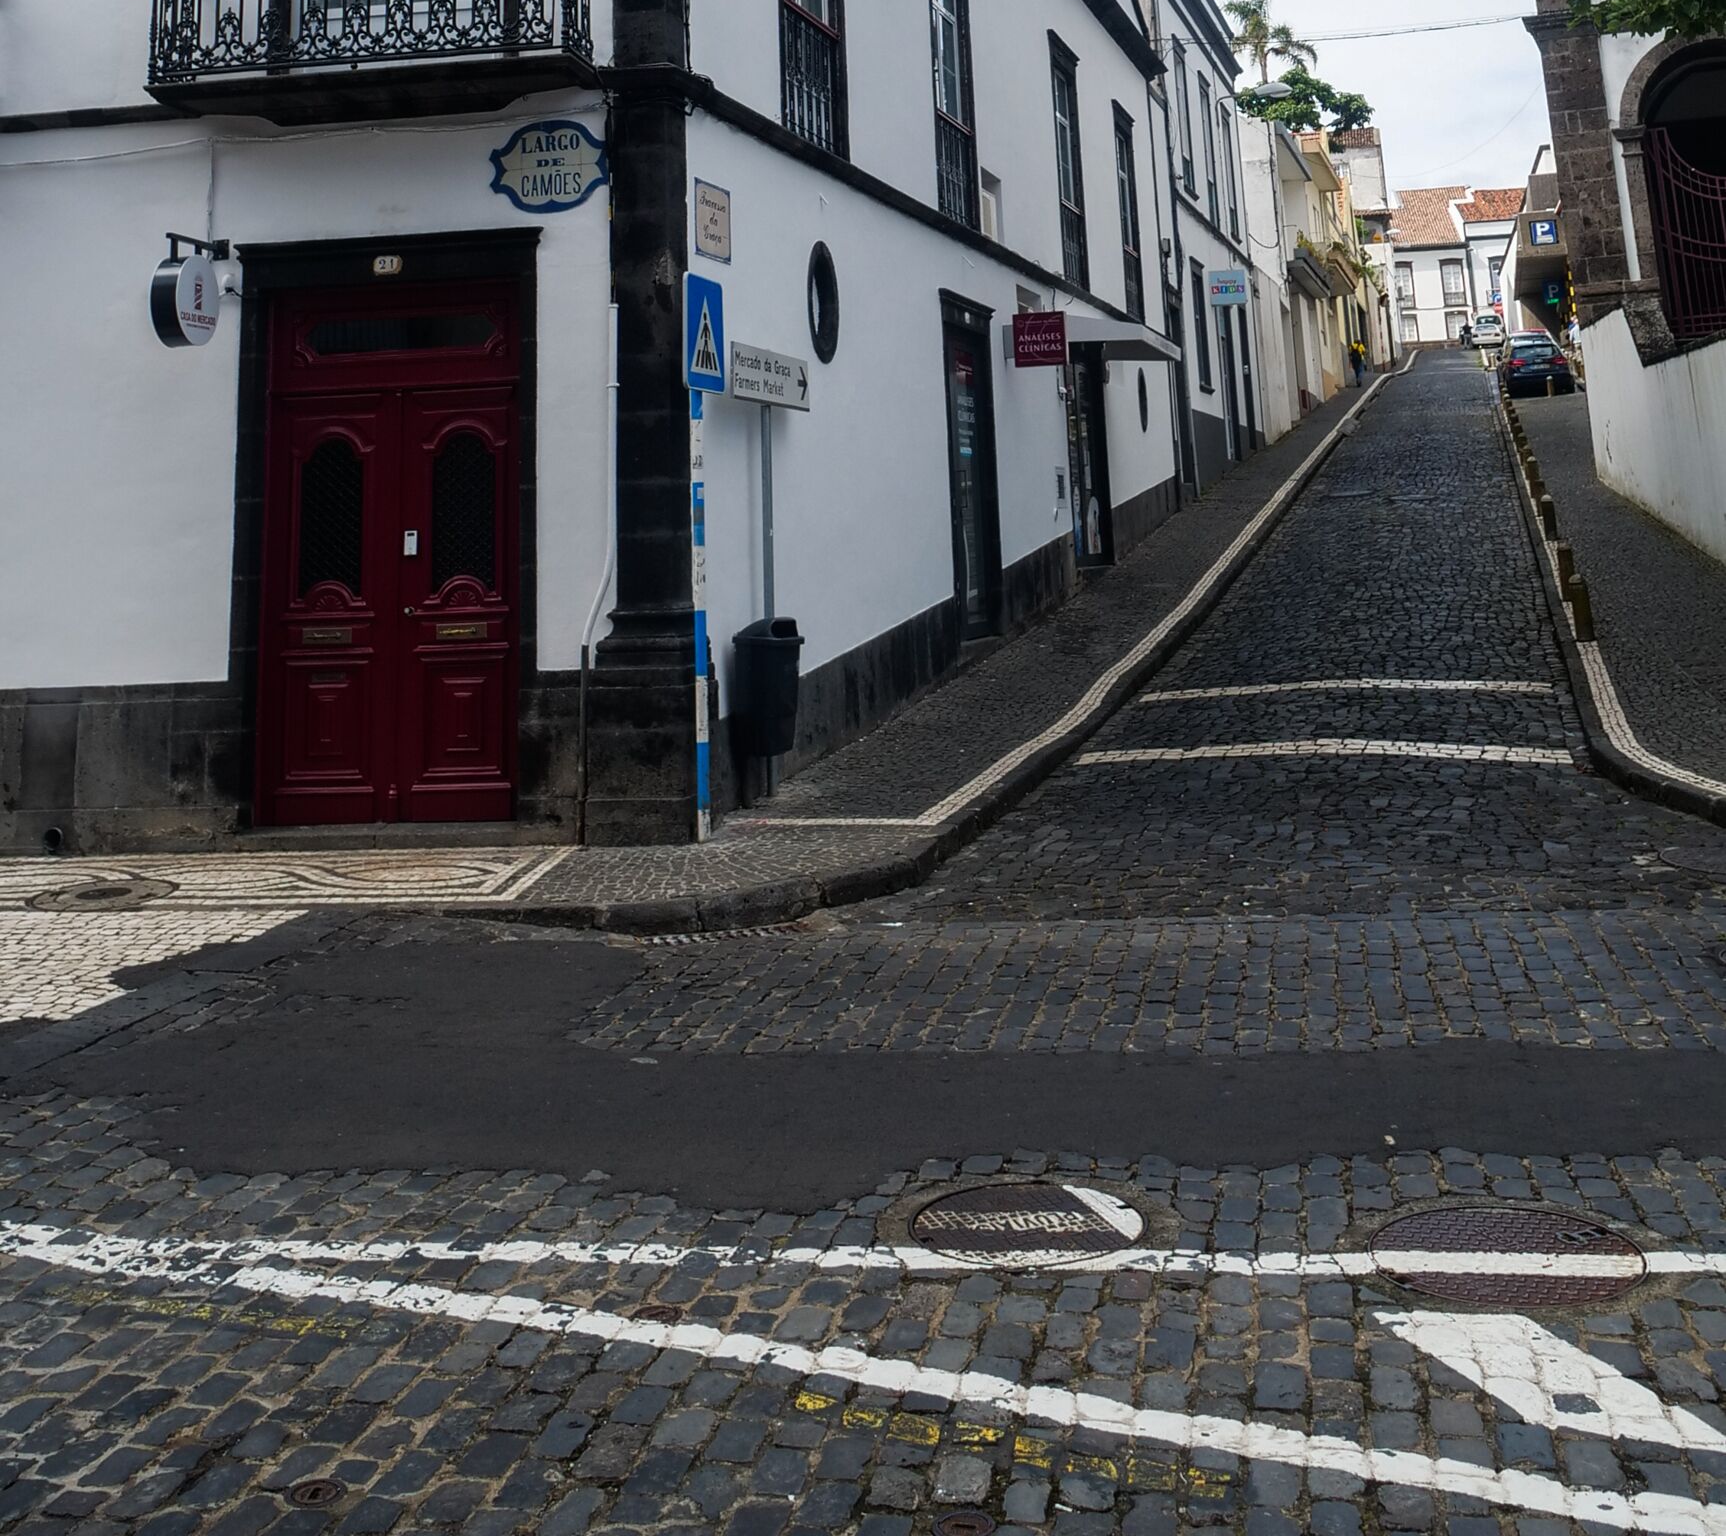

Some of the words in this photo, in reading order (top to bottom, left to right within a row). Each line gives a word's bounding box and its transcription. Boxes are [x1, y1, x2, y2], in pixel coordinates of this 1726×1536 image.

[520, 133, 580, 154] LARGO
[535, 157, 566, 168] DE
[521, 169, 582, 198] CAMÕES
[1536, 223, 1550, 236] P
[378, 259, 394, 270] 21
[1211, 285, 1245, 295] KIDS
[1548, 285, 1559, 298] P
[735, 350, 761, 371] Mercado
[764, 358, 772, 373] da
[774, 360, 791, 380] Graça
[735, 372, 760, 392] Farmers
[763, 378, 784, 397] Market
